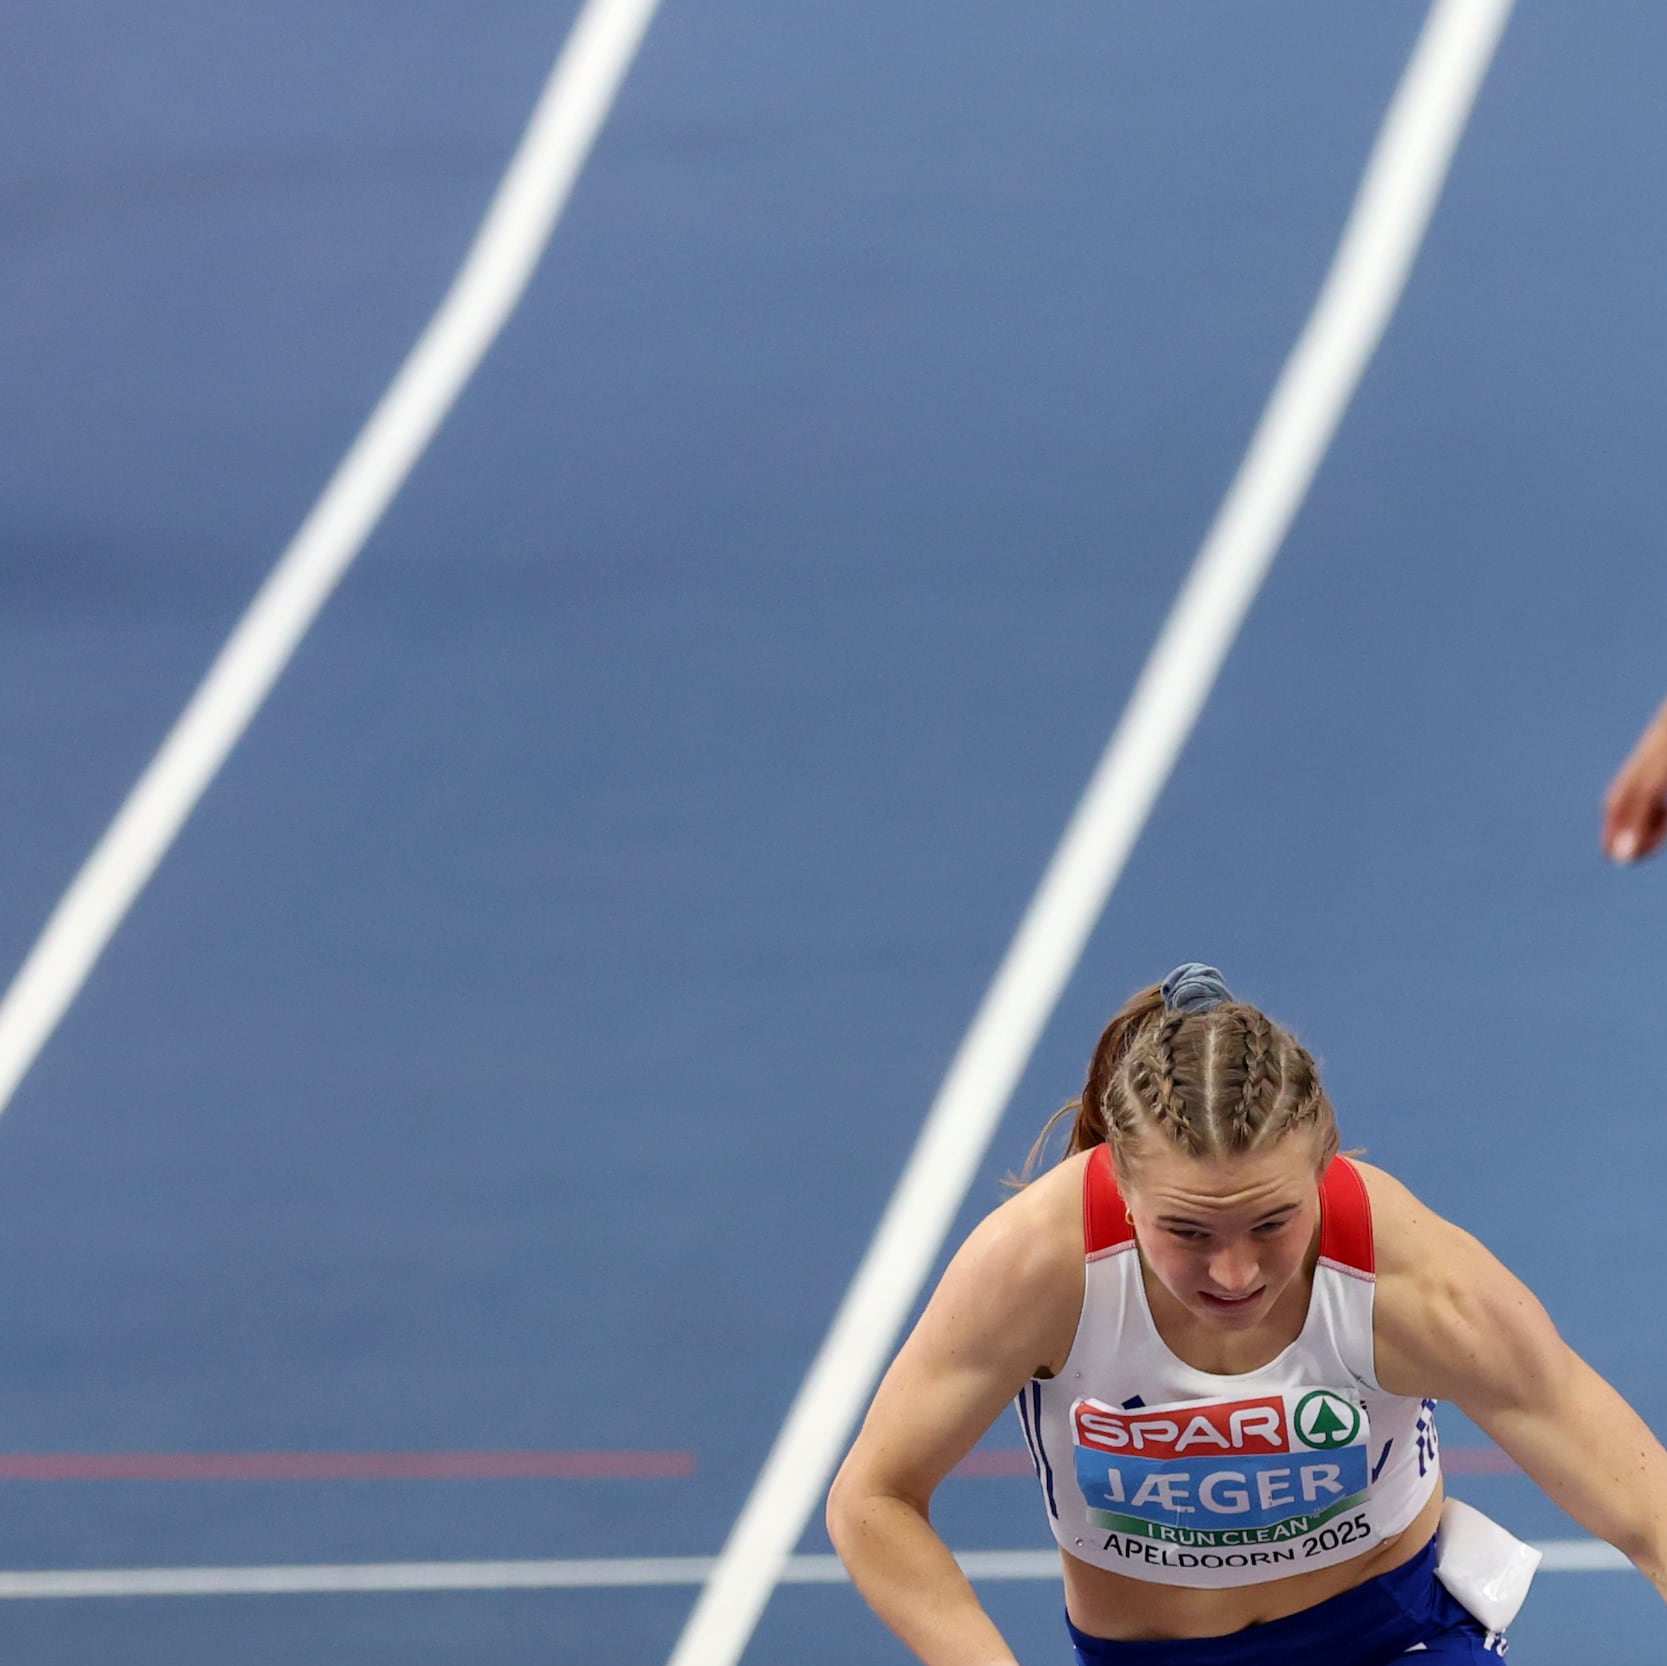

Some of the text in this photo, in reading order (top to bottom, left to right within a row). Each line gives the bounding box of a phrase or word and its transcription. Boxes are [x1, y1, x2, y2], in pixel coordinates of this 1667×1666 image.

[1079, 1406, 1283, 1452] SPAR
[1104, 1464, 1345, 1514] JÆGER
[1103, 1513, 1372, 1569] APELDOORN 2025
[1147, 1523, 1154, 1538] I
[1160, 1526, 1217, 1546] RUN
